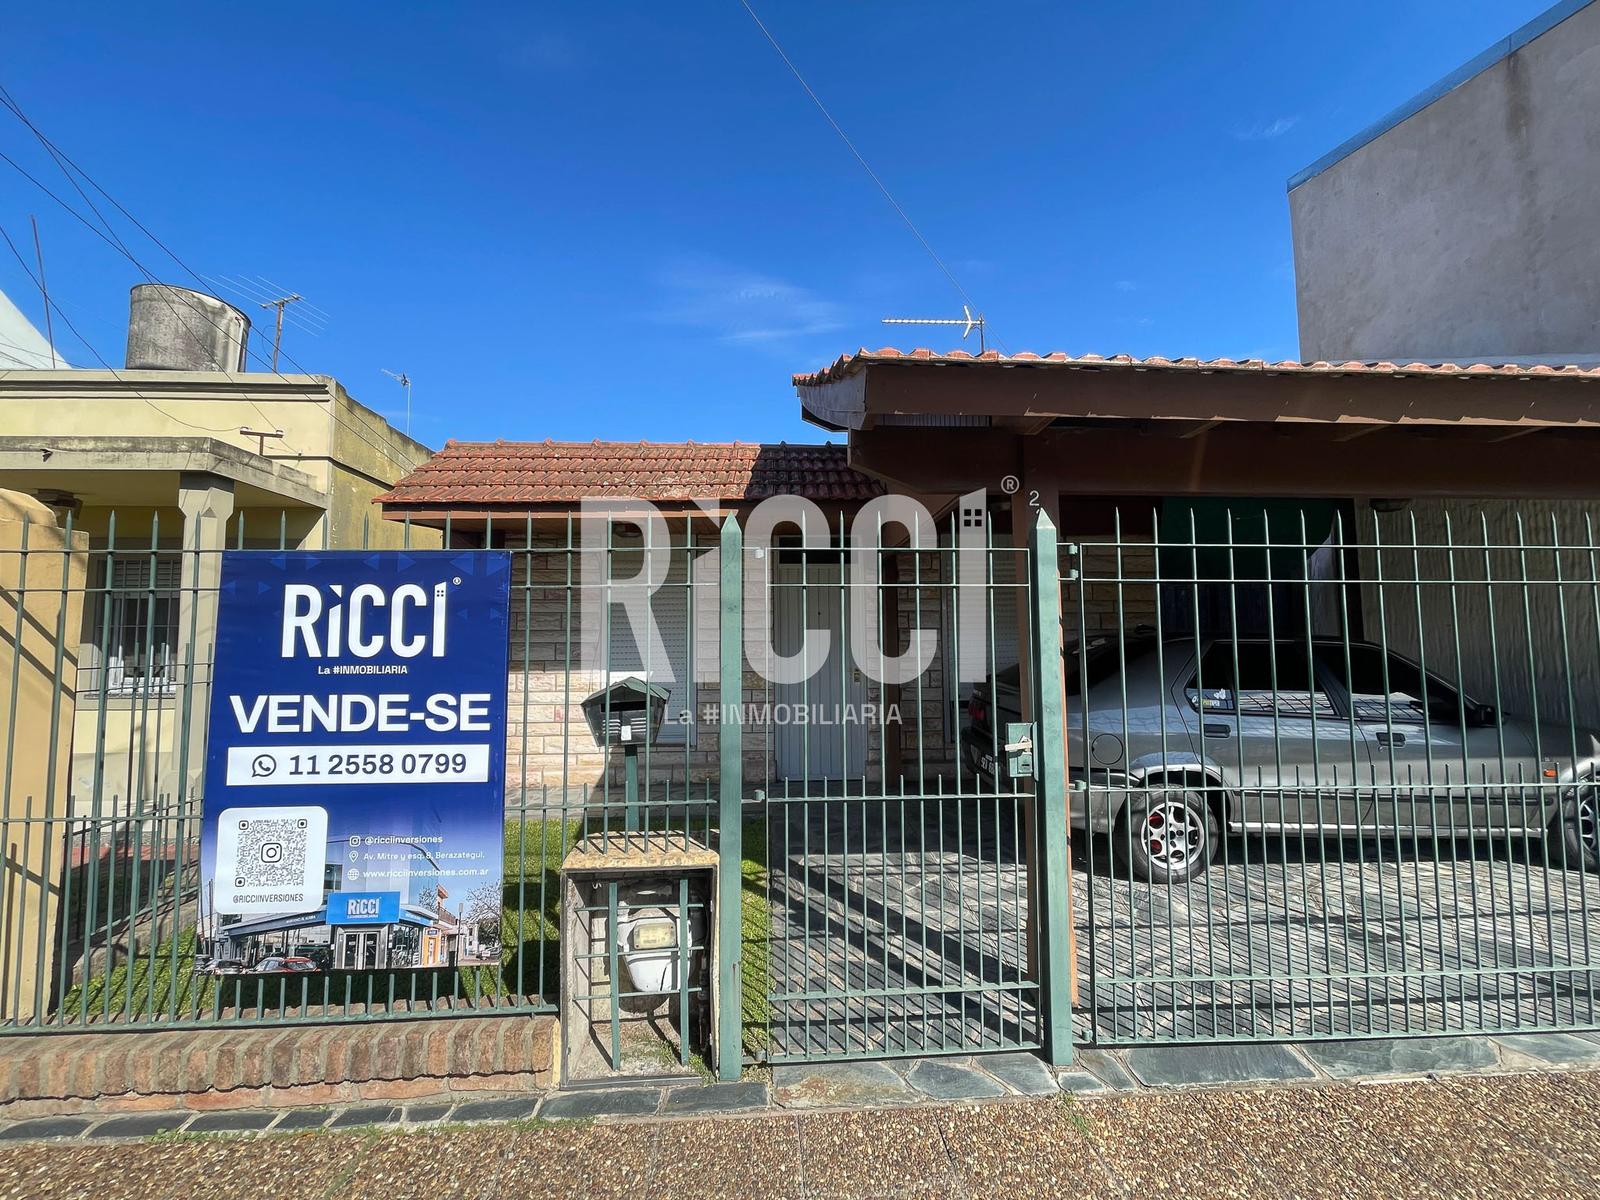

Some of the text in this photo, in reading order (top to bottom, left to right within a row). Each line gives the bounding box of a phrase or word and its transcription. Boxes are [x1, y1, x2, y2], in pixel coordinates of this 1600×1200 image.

[318, 665, 408, 675] La #INMOBILIARIA
[229, 693, 491, 734] VENDE-SE
[289, 753, 467, 776] 11 2558 0799
[364, 835, 443, 846] @ricciinversiones
[363, 852, 376, 861] Av.
[377, 852, 398, 861] Mitre
[400, 853, 406, 862] y
[362, 868, 489, 879] www.ricciinversiones.com.ar
[232, 893, 304, 904] @RICCIINVERSIONES
